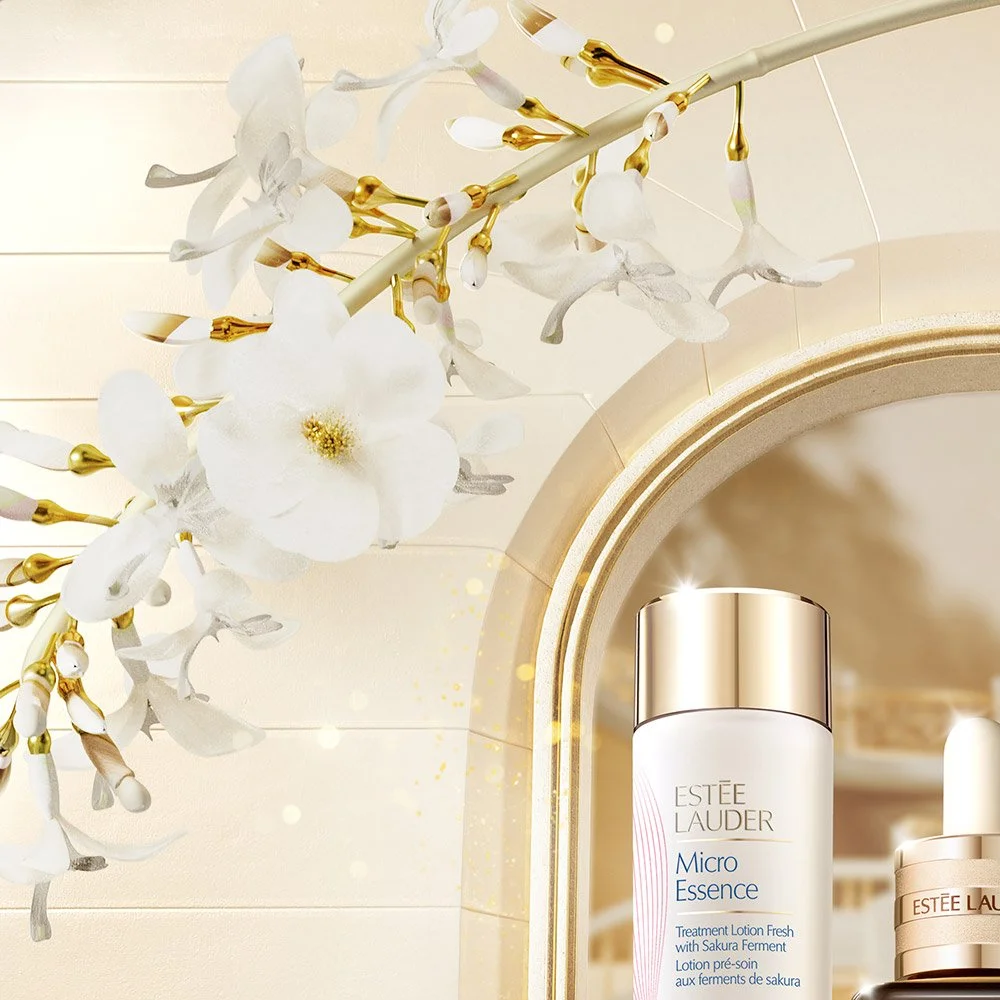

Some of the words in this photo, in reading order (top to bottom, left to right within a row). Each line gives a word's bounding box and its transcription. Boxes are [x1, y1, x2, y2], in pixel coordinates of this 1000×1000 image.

[675, 809, 774, 833] LAUDER
[676, 852, 738, 874] Micro
[676, 879, 759, 901] Essence
[676, 925, 728, 938] Treatment
[731, 925, 764, 936] Lotion
[767, 925, 794, 937] Fresh
[676, 940, 699, 953] with
[702, 939, 739, 952] Sakura
[742, 940, 786, 952] Ferment
[676, 959, 710, 972] Lotion
[713, 957, 758, 972] pré-soin
[675, 976, 696, 987] aux
[698, 974, 746, 986] ferments
[749, 975, 763, 985] de
[766, 975, 801, 987] sakura
